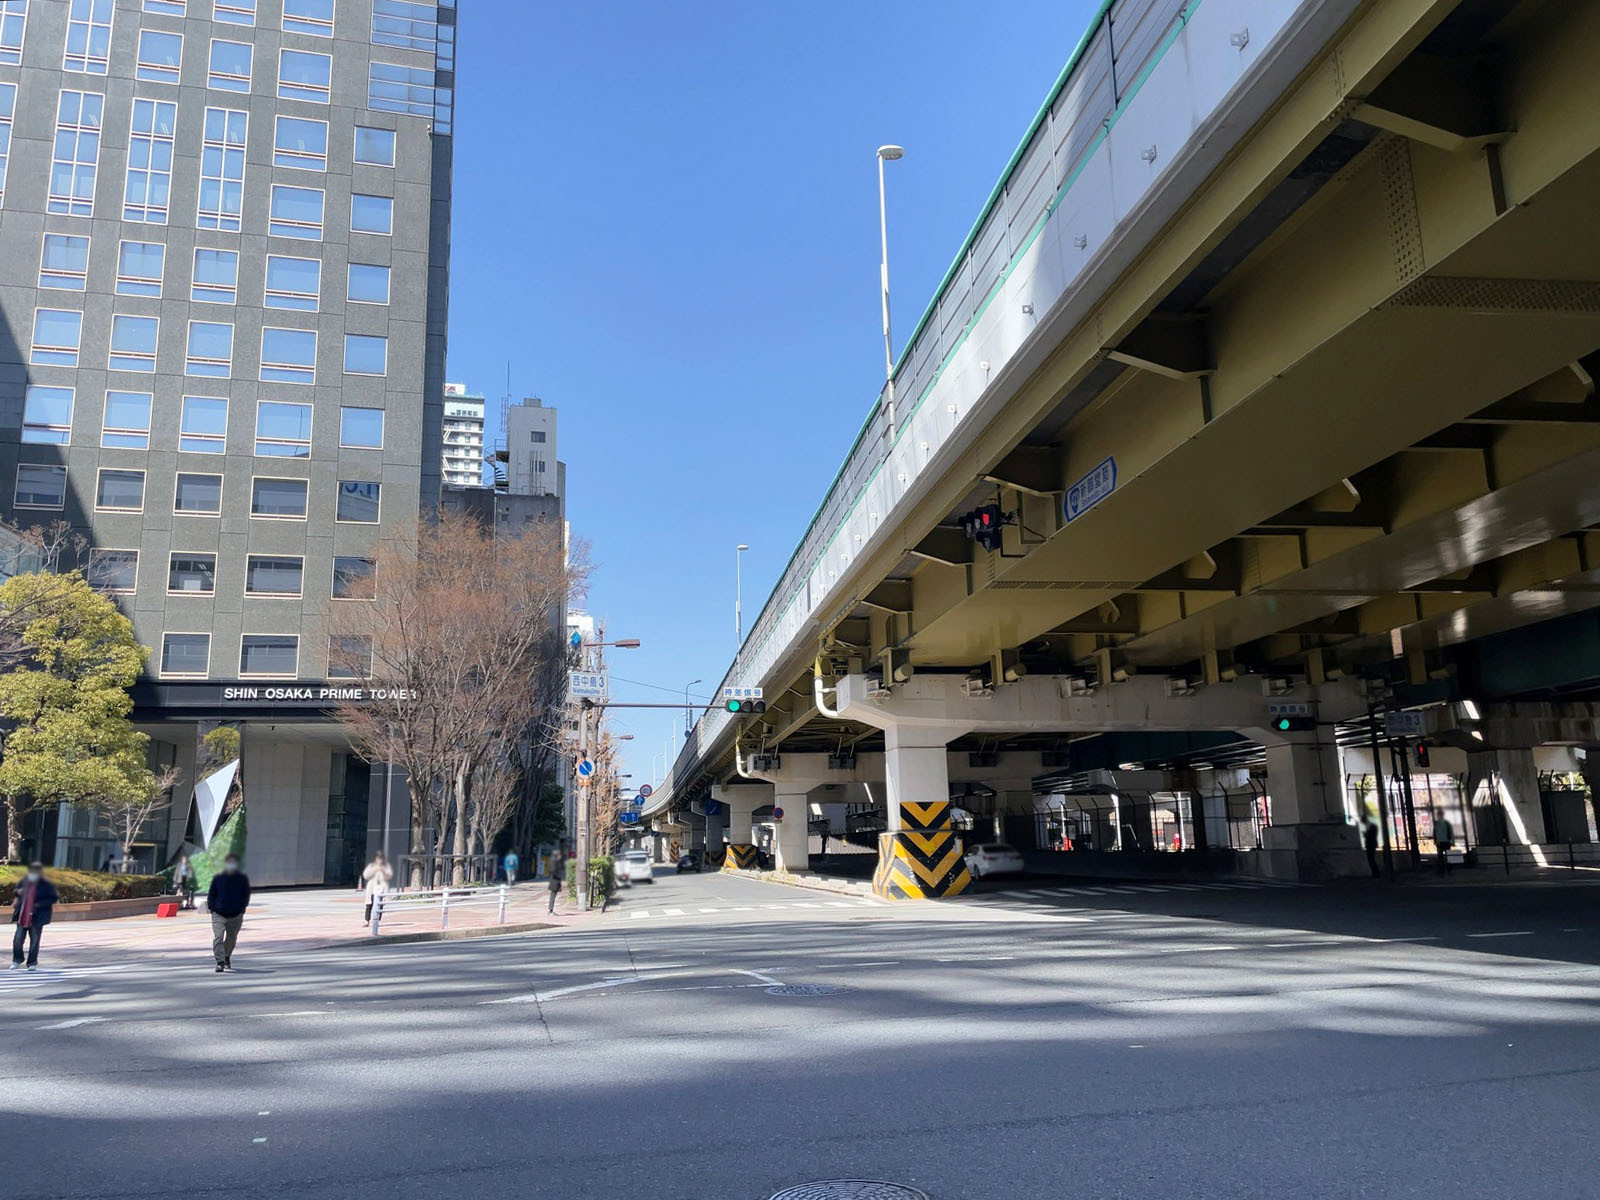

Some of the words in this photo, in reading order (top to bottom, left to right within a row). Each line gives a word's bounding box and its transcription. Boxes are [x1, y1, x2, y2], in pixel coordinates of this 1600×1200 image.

[224, 688, 258, 699] SHIN
[264, 688, 313, 699] OSAKA
[319, 688, 362, 699] PRIME
